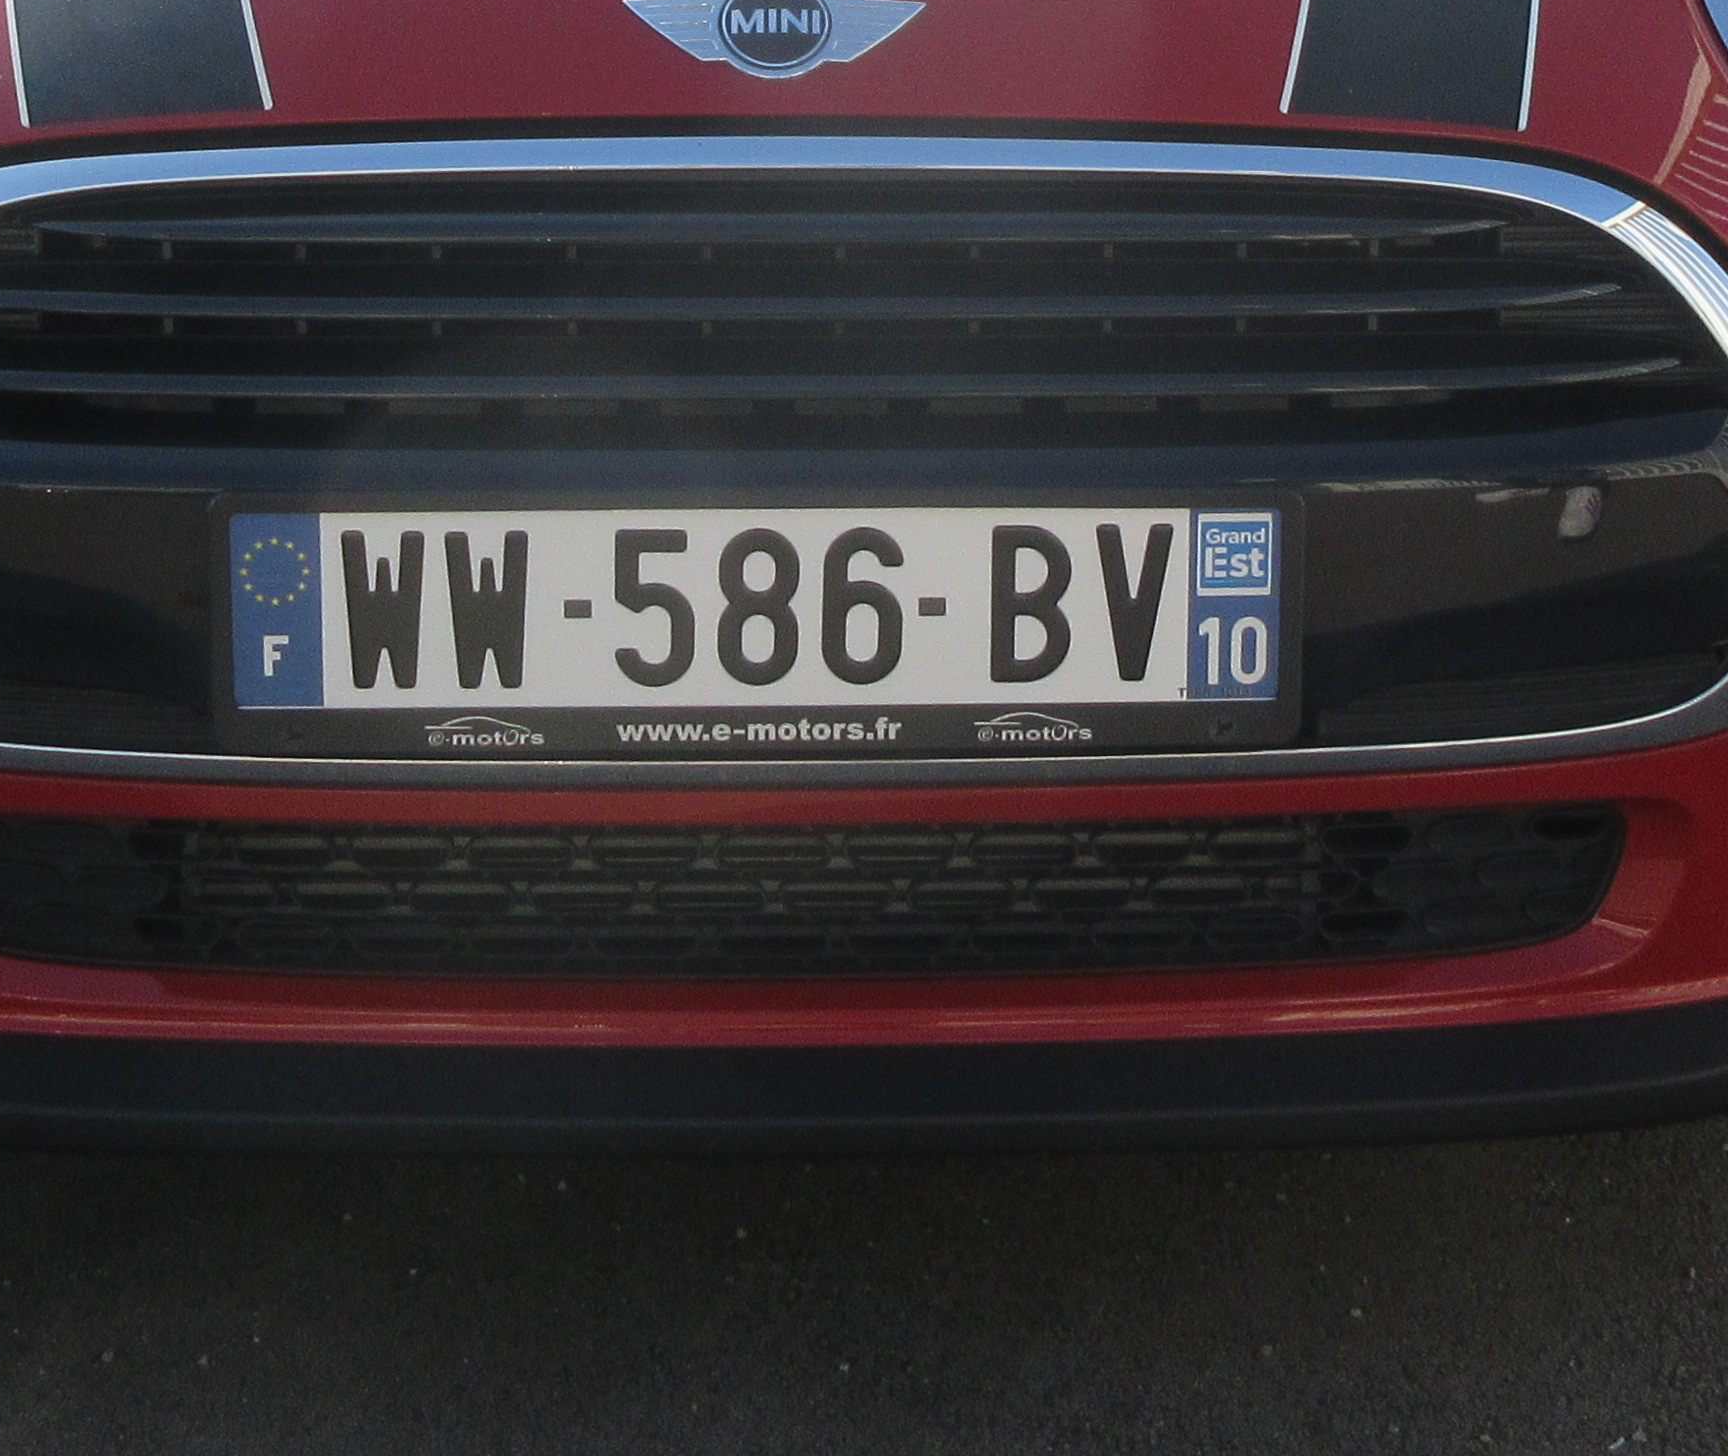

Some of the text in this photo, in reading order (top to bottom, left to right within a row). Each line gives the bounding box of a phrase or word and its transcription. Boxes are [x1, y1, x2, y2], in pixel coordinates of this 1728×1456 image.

[730, 8, 821, 35] MINI
[1205, 527, 1266, 545] Grand
[1204, 546, 1265, 578] Est
[263, 634, 290, 677] F
[1198, 616, 1268, 686] 10
[616, 716, 903, 742] www.e-motors.fr
